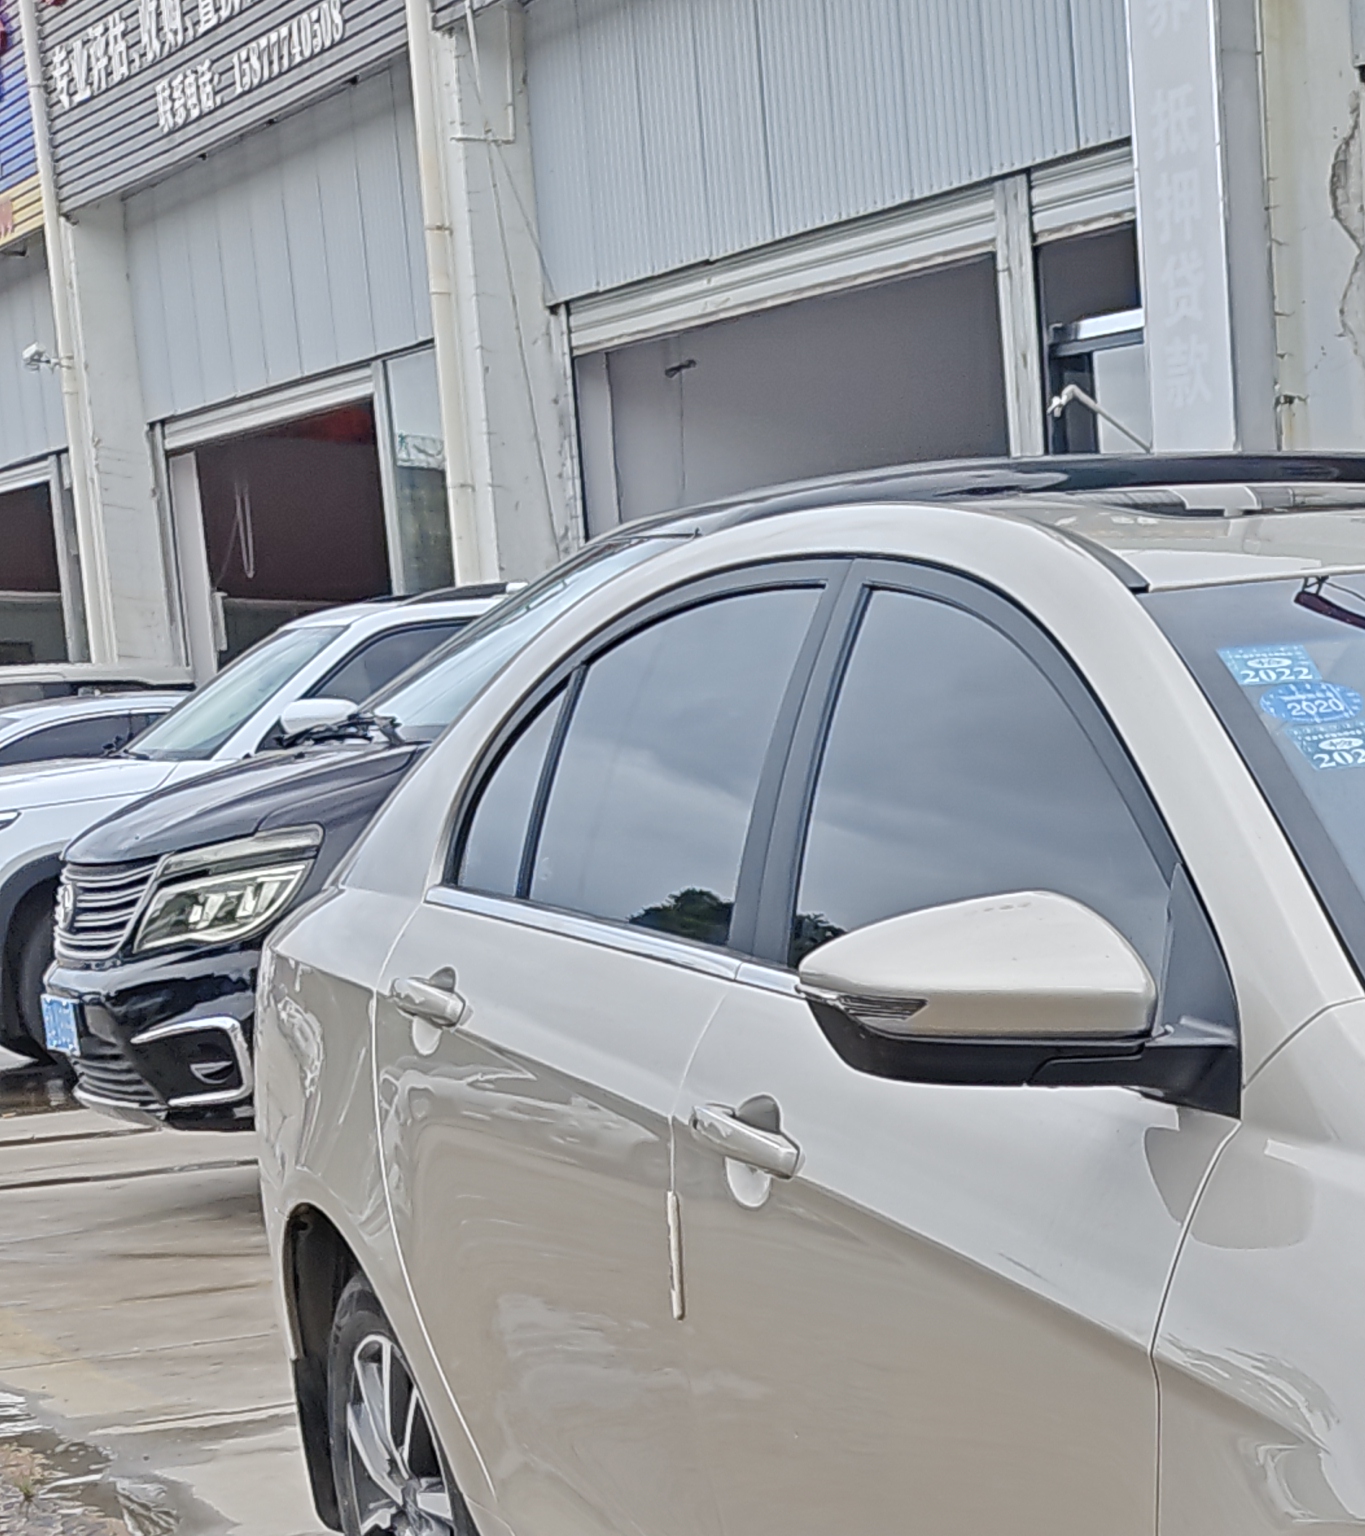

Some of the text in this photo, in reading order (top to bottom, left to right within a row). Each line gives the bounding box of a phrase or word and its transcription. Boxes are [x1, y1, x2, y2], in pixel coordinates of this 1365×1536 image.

[1150, 82, 1212, 409] 抵押贷款
[1240, 667, 1313, 683] 2022
[1287, 697, 1344, 716] 2020
